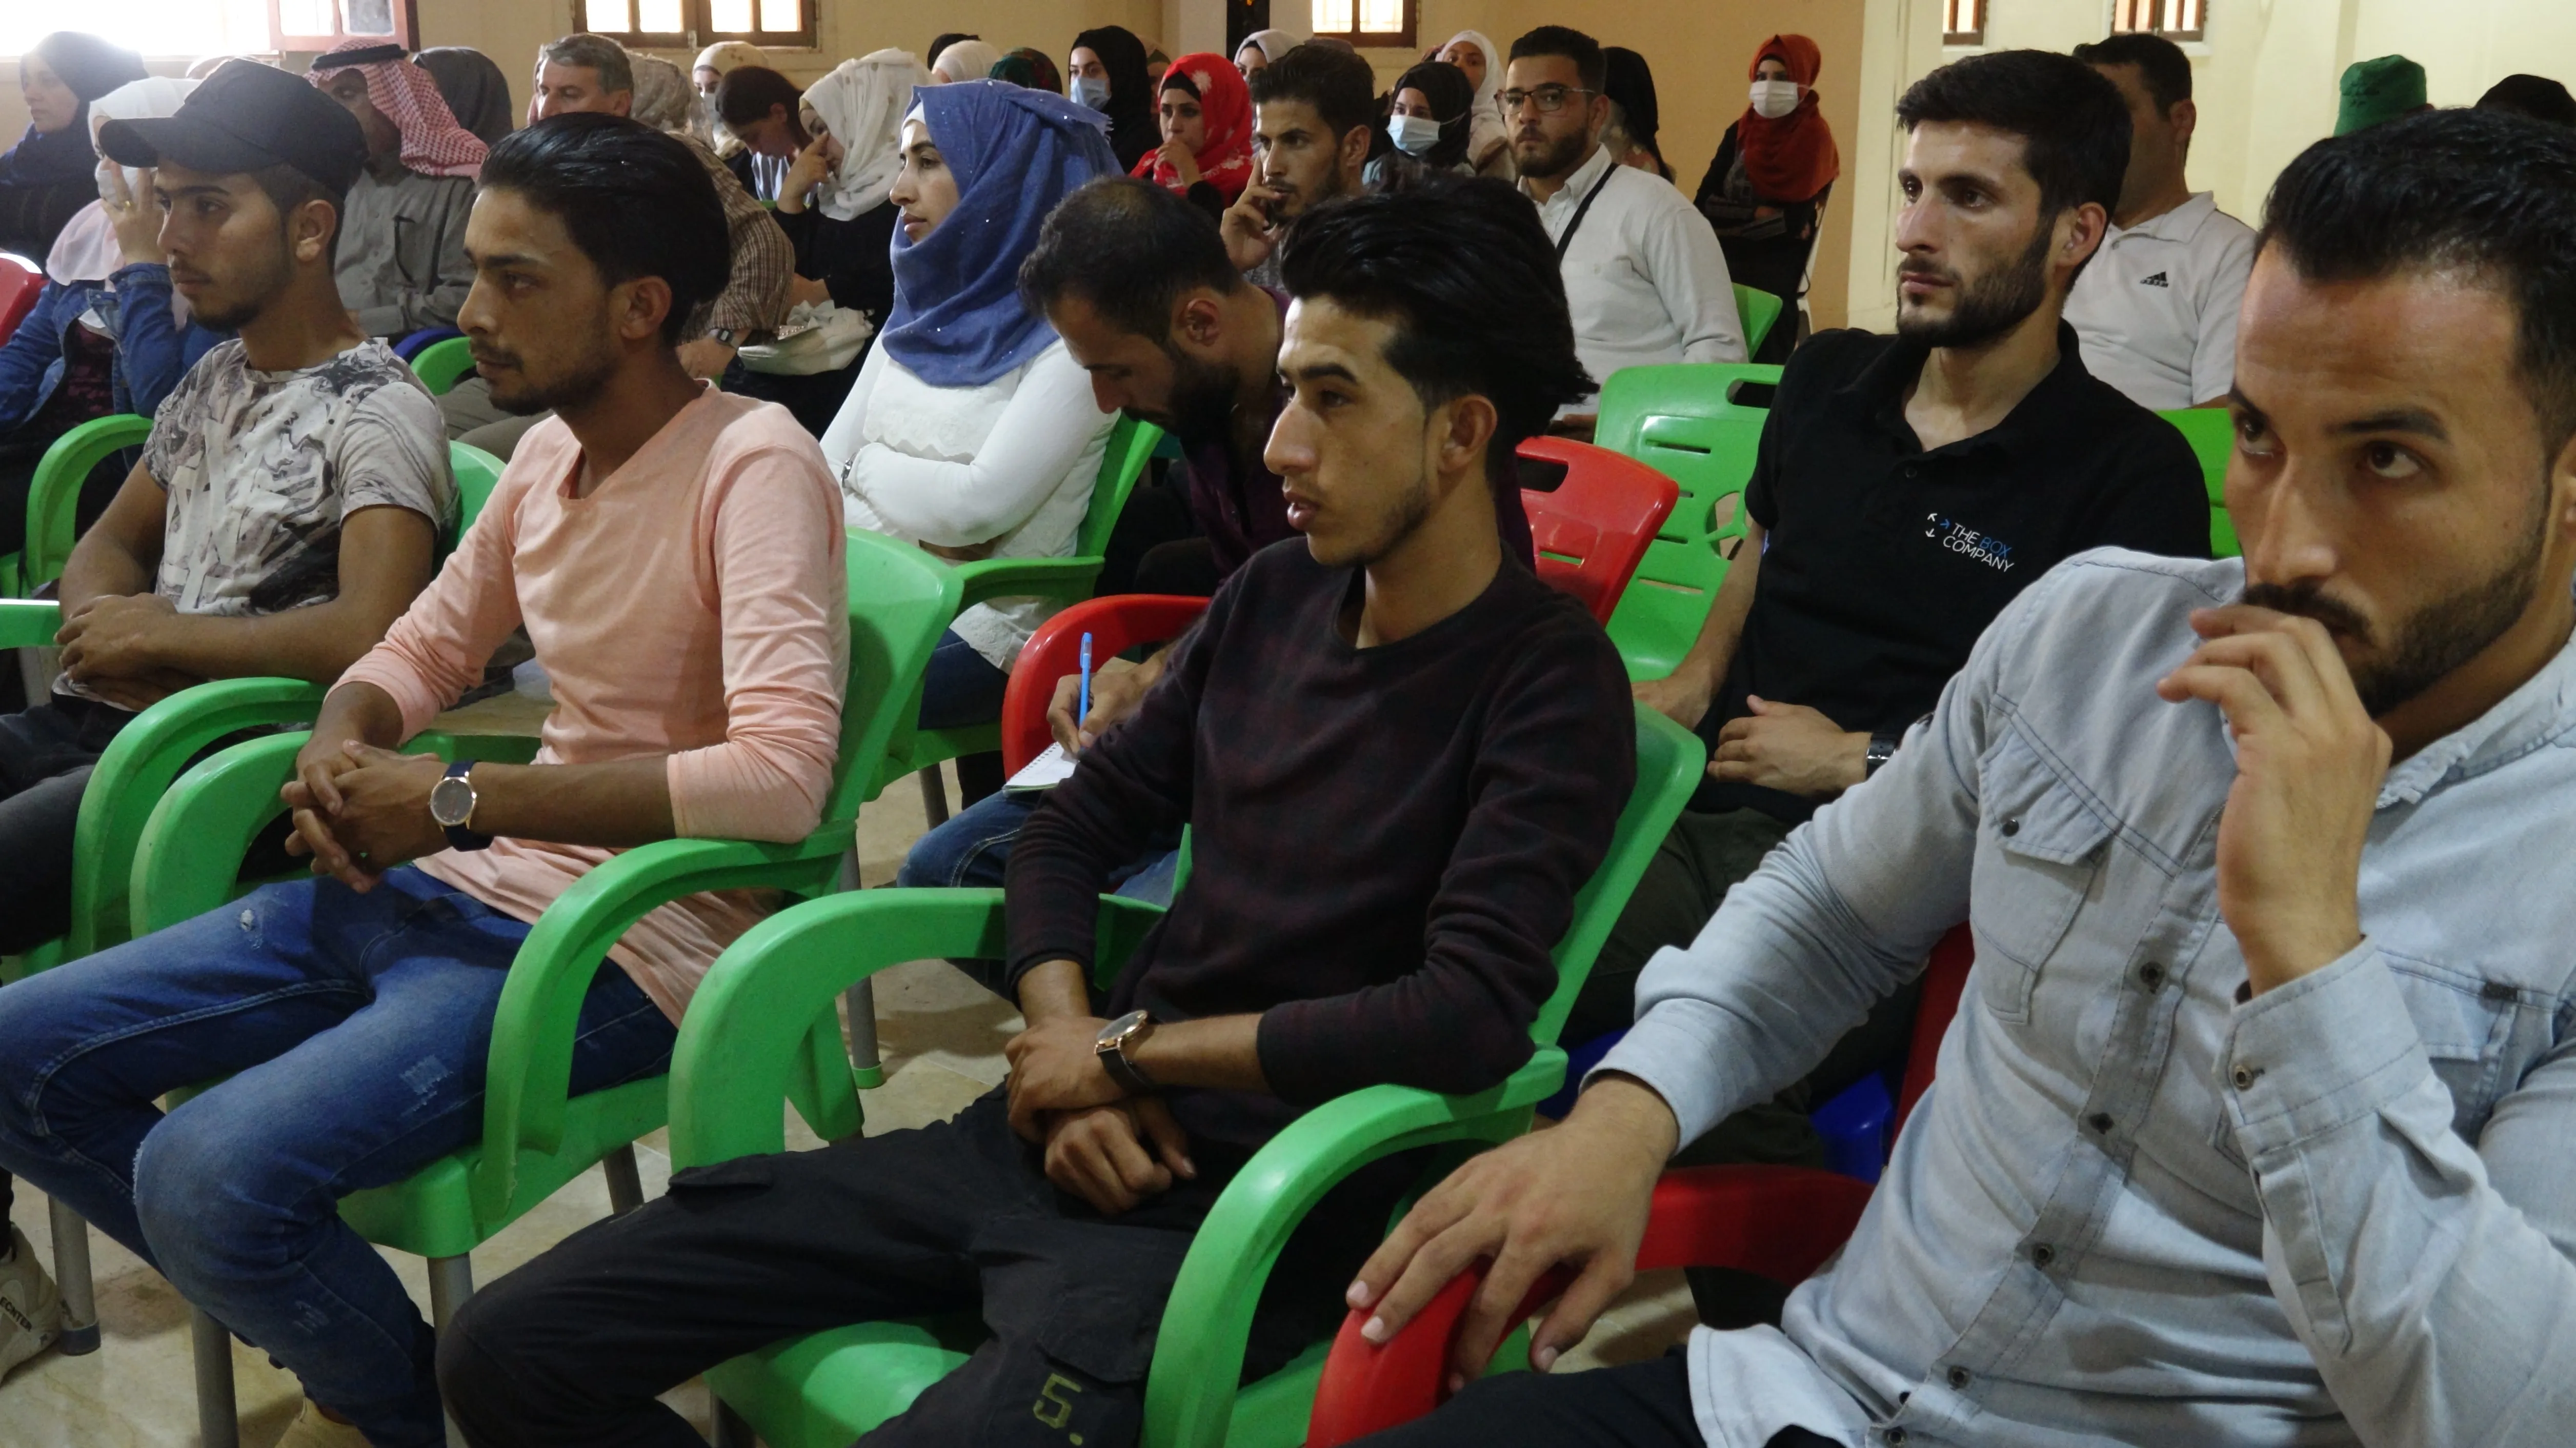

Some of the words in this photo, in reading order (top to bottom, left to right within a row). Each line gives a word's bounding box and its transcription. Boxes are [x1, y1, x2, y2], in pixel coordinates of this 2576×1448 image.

[1943, 535, 2015, 573] COMPANY
[1951, 522, 1981, 545] THE
[1979, 537, 2012, 559] BOX
